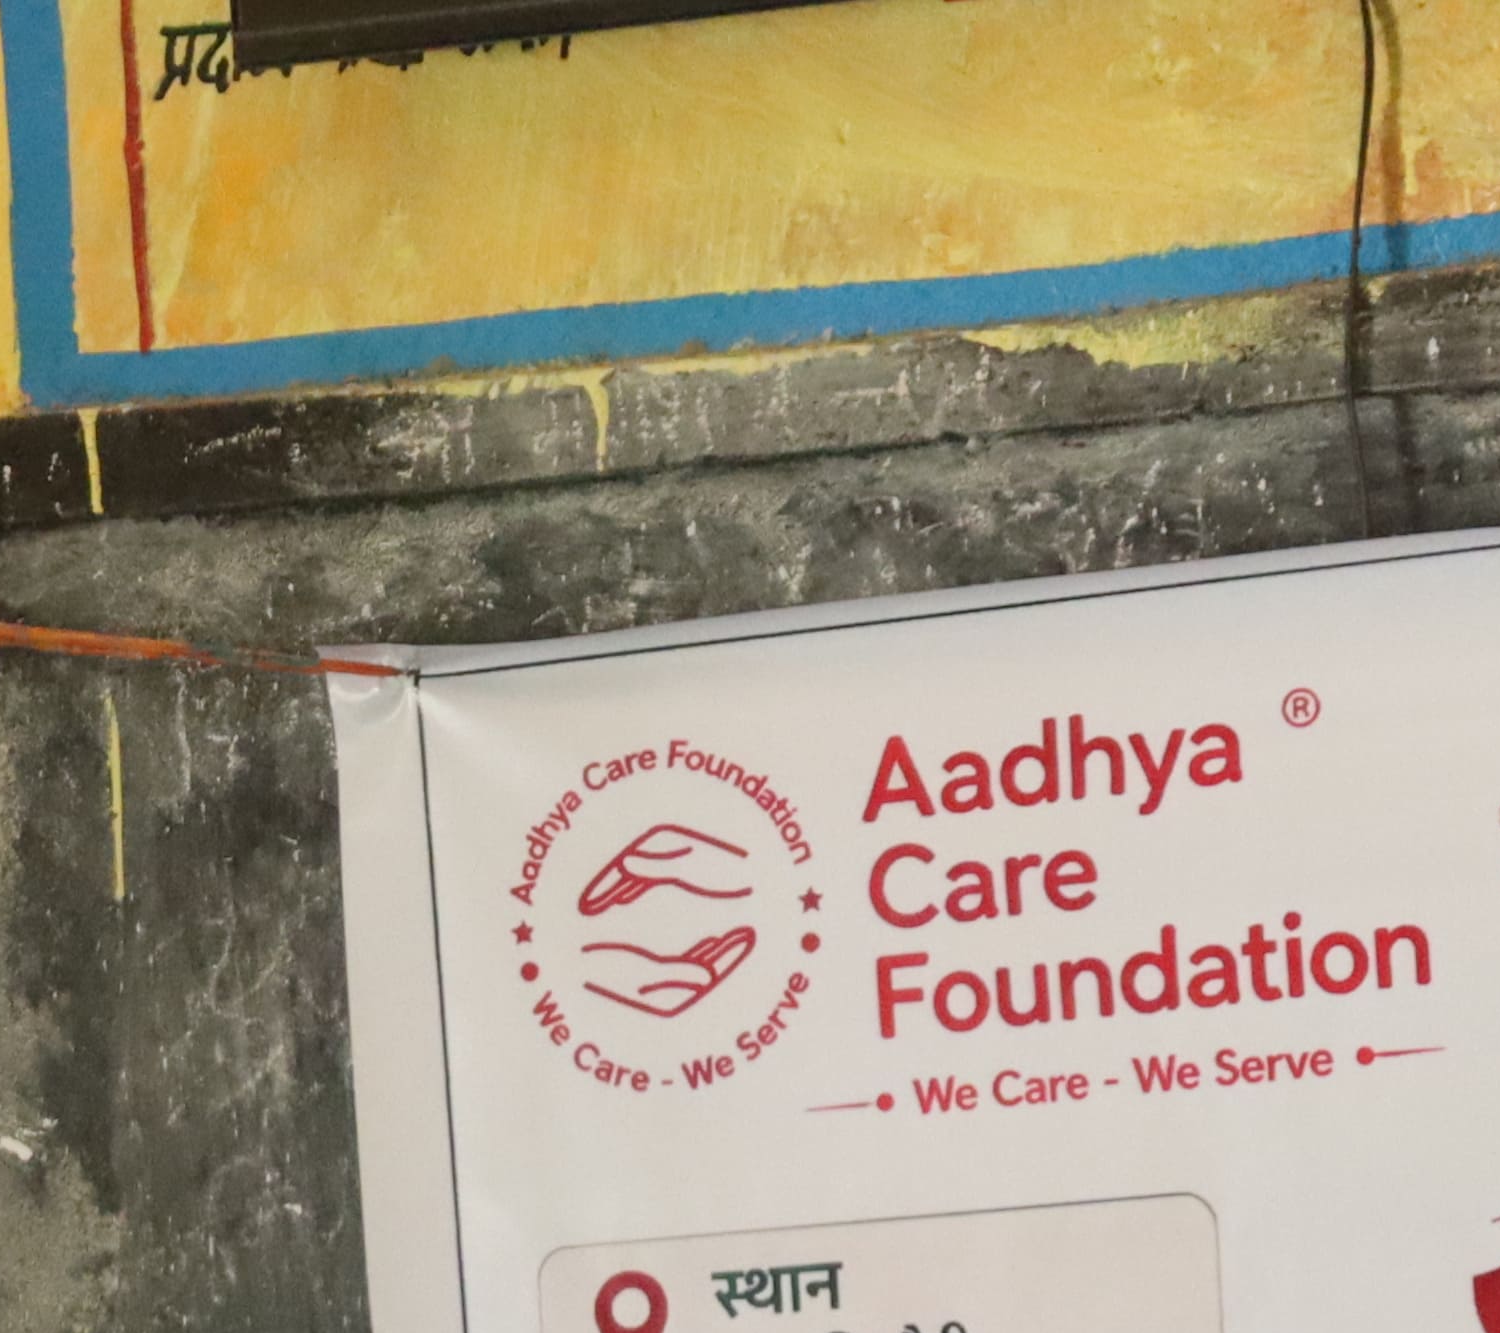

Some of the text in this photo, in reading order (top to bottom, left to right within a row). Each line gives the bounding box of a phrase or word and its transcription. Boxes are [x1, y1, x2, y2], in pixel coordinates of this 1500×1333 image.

[862, 715, 1242, 822] Aadhya
[510, 740, 812, 906] Aadhya Care Foundation
[869, 843, 1097, 928] Care
[876, 911, 1432, 1040] Foundation
[533, 972, 810, 1092] We Care We Serve
[913, 1076, 977, 1114] We
[992, 1070, 1089, 1107] Care
[1132, 1055, 1200, 1093] We
[1215, 1049, 1333, 1086] Serve
[712, 1262, 842, 1318] स्थान
